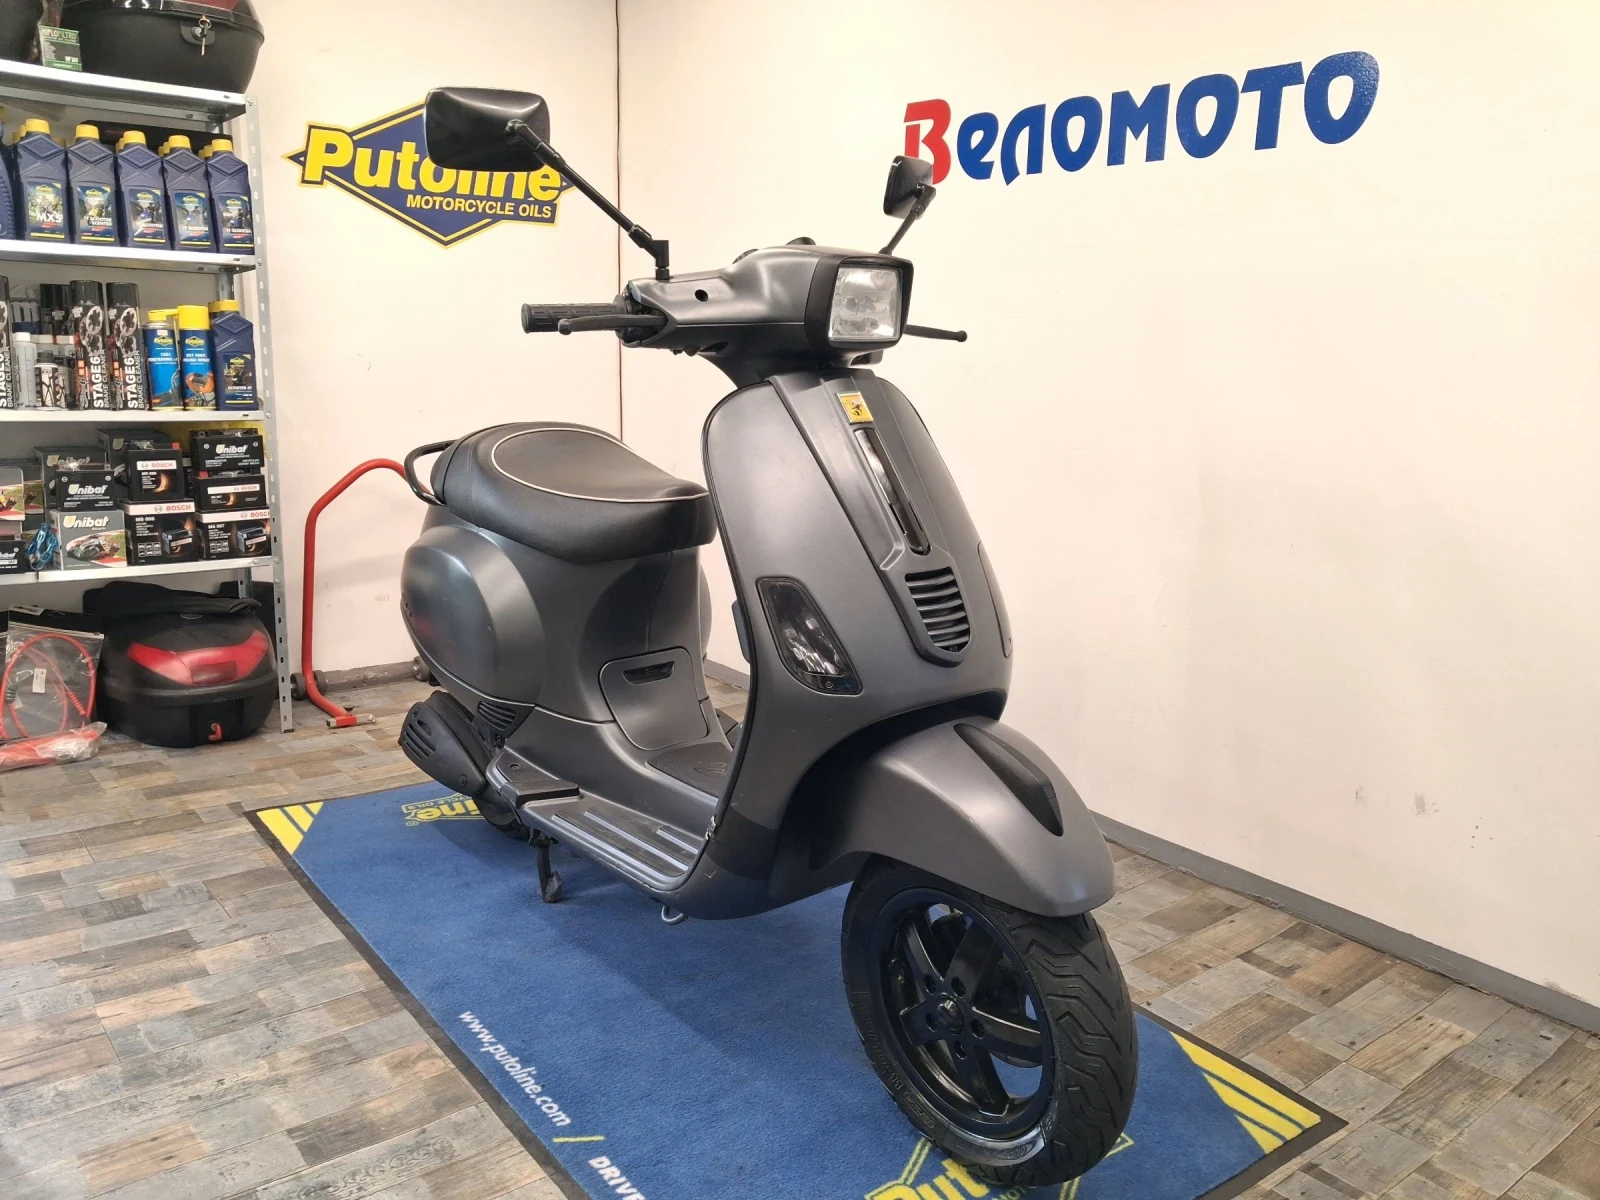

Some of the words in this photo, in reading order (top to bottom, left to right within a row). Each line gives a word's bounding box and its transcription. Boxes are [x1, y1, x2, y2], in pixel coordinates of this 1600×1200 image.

[406, 194, 515, 216] MOTORCYCLE
[518, 203, 552, 219] OILS
[90, 356, 104, 408] STAGE6
[124, 356, 139, 409] STAGE6
[215, 443, 249, 454] Unibat
[67, 483, 108, 495] Unibat
[165, 504, 191, 512] BOSCH
[63, 515, 109, 528] Unibat
[459, 1011, 572, 1127] www.putoline.com
